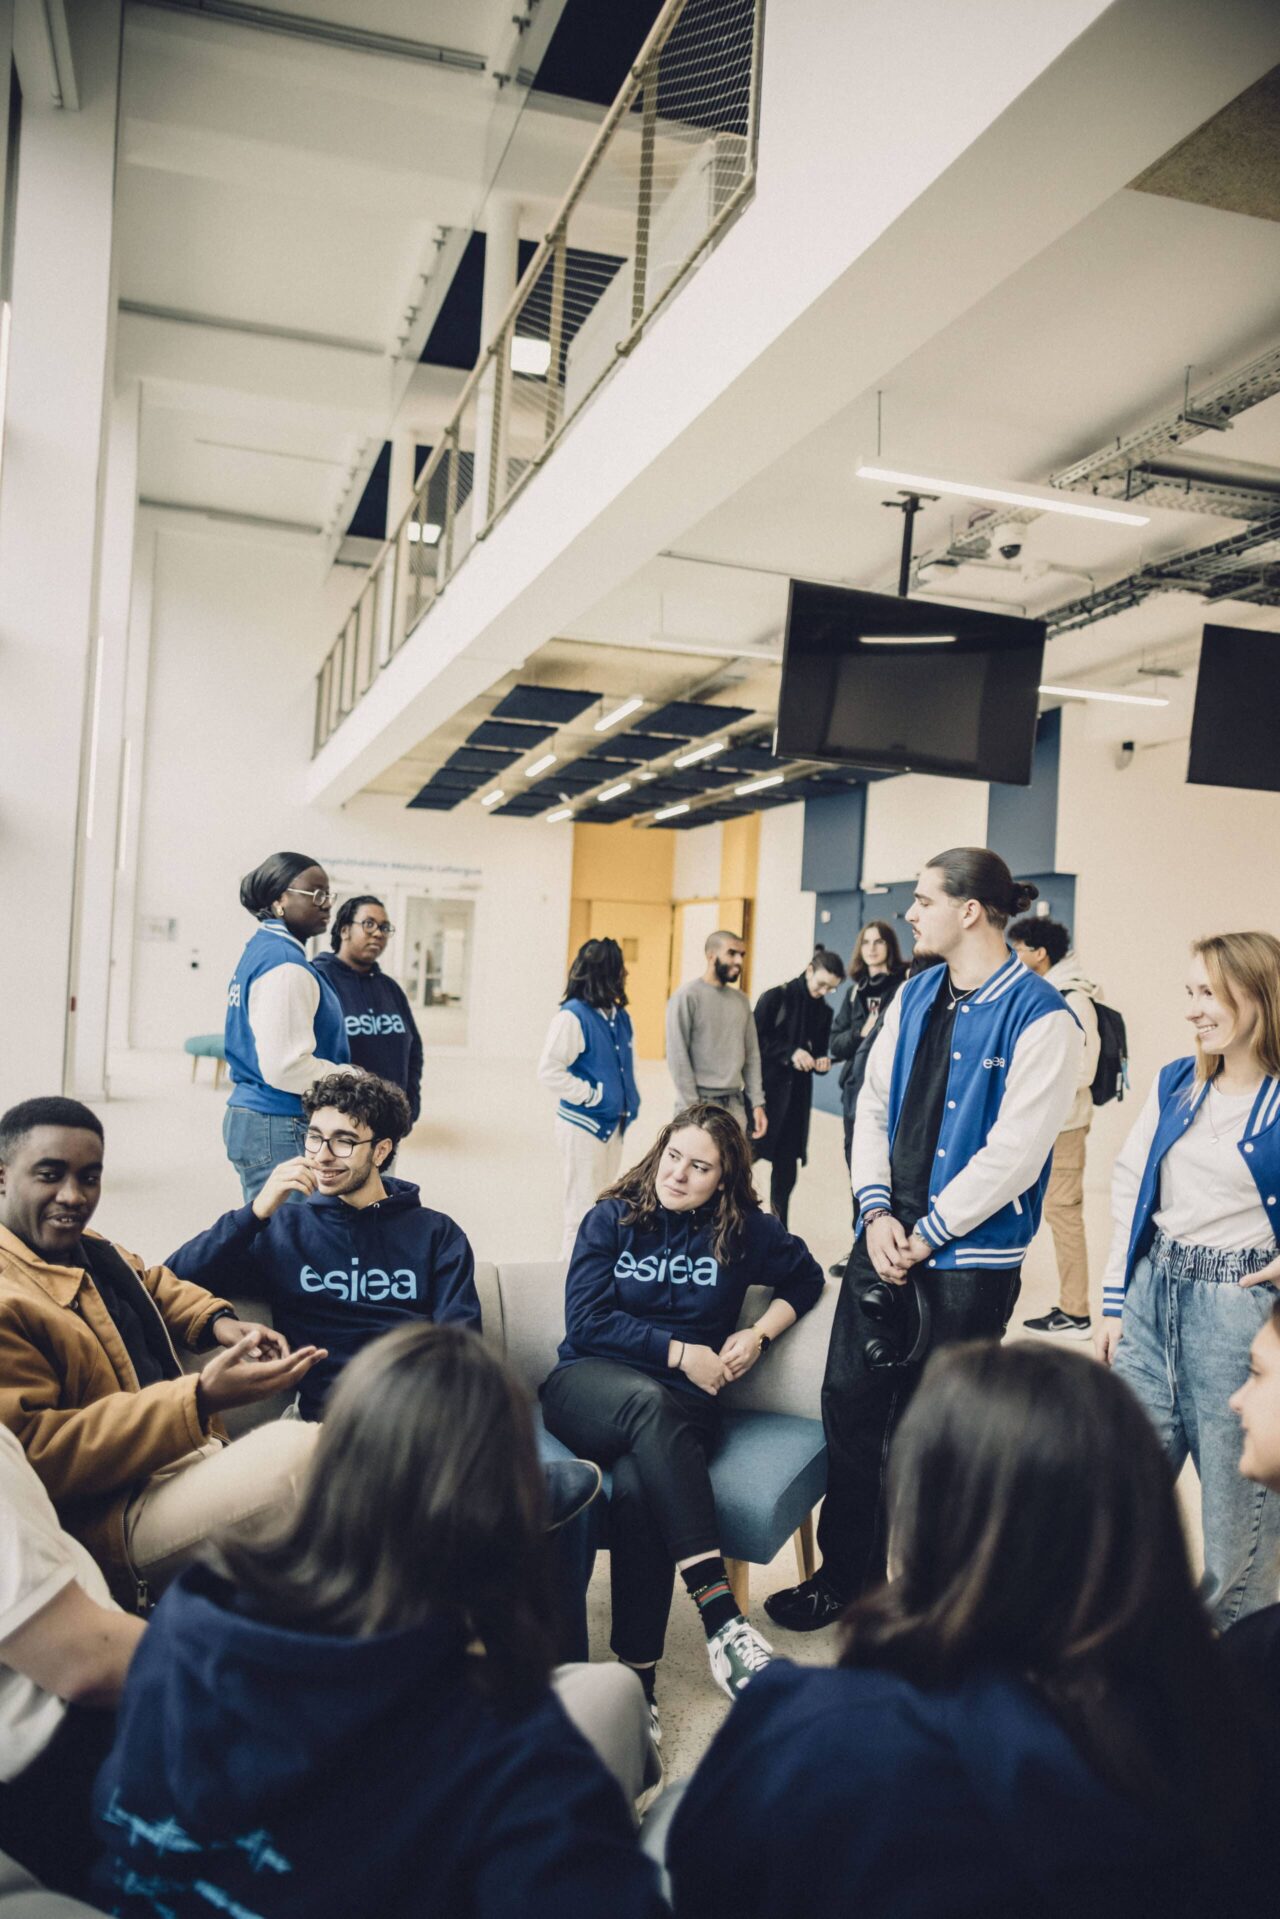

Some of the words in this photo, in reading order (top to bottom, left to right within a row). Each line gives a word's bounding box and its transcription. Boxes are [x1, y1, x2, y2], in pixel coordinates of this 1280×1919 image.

[344, 1008, 406, 1036] esiea
[300, 1257, 417, 1302] esiea
[614, 1248, 718, 1287] esiea
